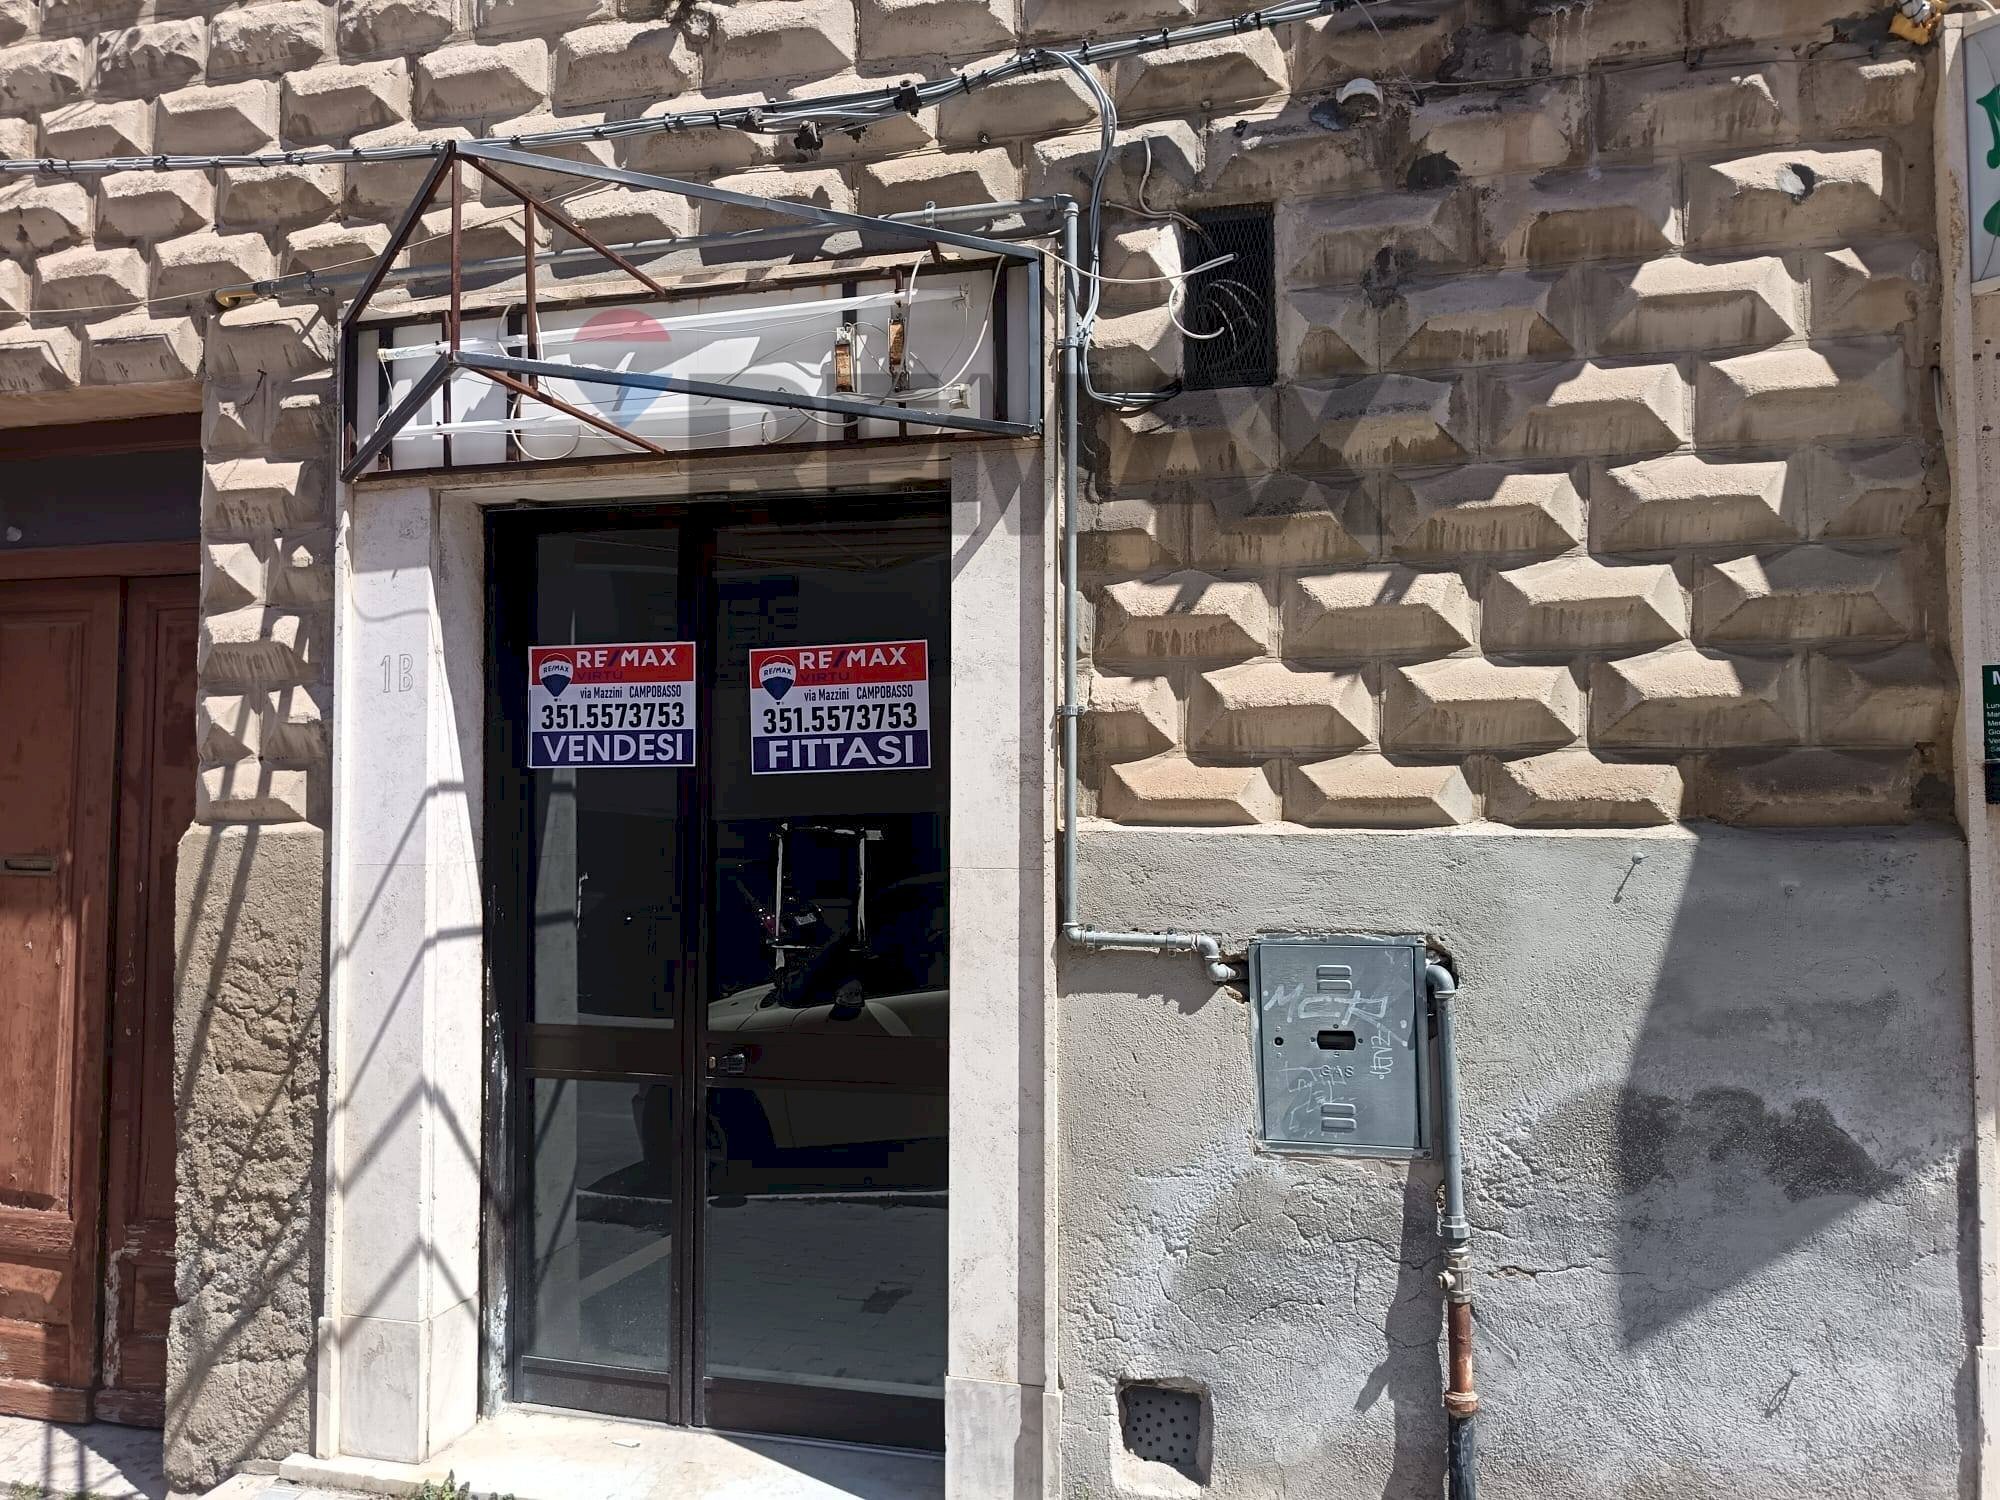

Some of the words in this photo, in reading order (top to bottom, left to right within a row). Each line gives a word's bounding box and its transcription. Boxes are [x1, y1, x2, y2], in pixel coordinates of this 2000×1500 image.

[543, 664, 569, 674] RE/MAX
[576, 648, 677, 669] RE/MAX
[800, 647, 907, 670] RE/MAX
[763, 666, 792, 677] RE/MAX
[580, 688, 592, 699] via
[594, 686, 622, 699] Mazzini
[629, 684, 682, 698] CAMPOBASSO
[804, 690, 816, 702] via
[819, 688, 849, 701] Mazzini
[856, 684, 913, 700] CAMPOBASSO
[541, 702, 684, 729] 351.5573753
[763, 702, 917, 734] 351.5573753
[542, 733, 683, 762] VENDESI
[768, 735, 914, 769] FITTASI
[1320, 1064, 1354, 1078] GAS
